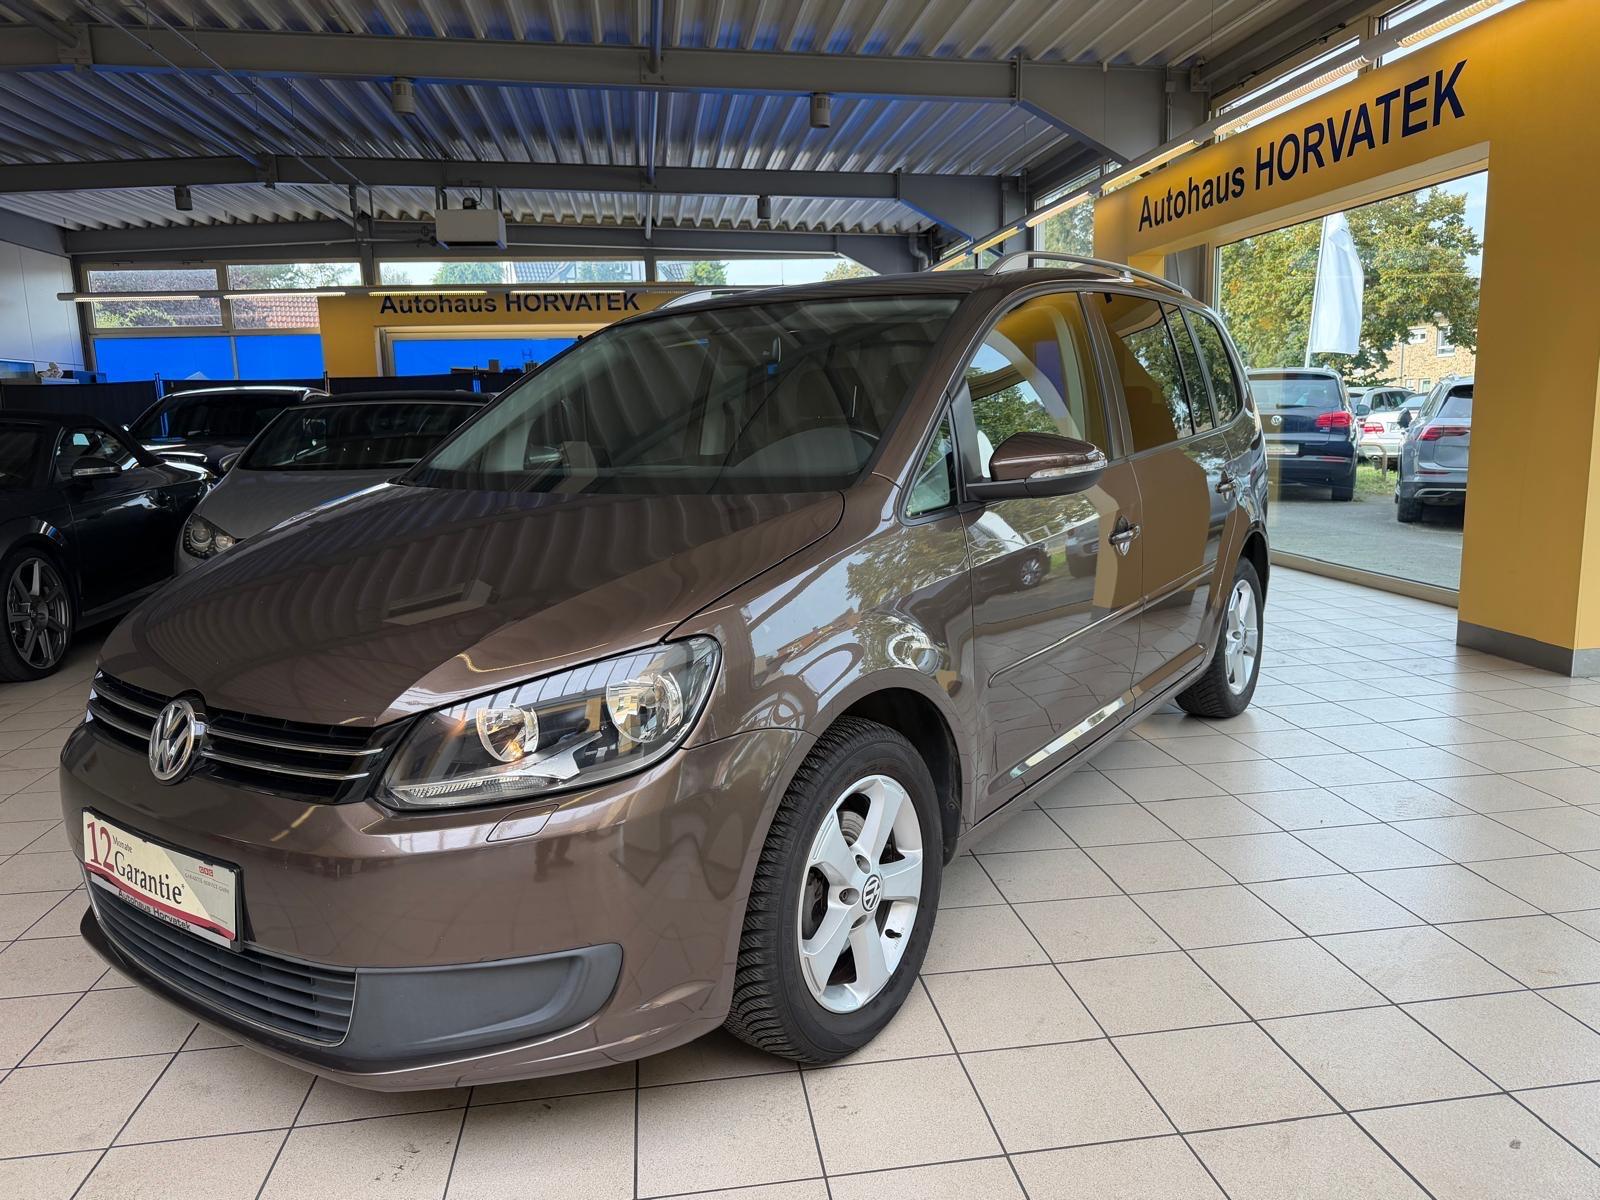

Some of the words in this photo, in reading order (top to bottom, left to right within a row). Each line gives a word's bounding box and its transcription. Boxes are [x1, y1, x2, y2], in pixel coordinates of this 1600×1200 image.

[1138, 166, 1245, 232] Autohaus
[1255, 59, 1468, 191] HORVATEK
[380, 295, 497, 314] Autohaus
[505, 292, 640, 312] HORVATEK
[87, 821, 115, 873] 12
[118, 889, 151, 913] Autohaus
[153, 906, 191, 931] Horvatek
